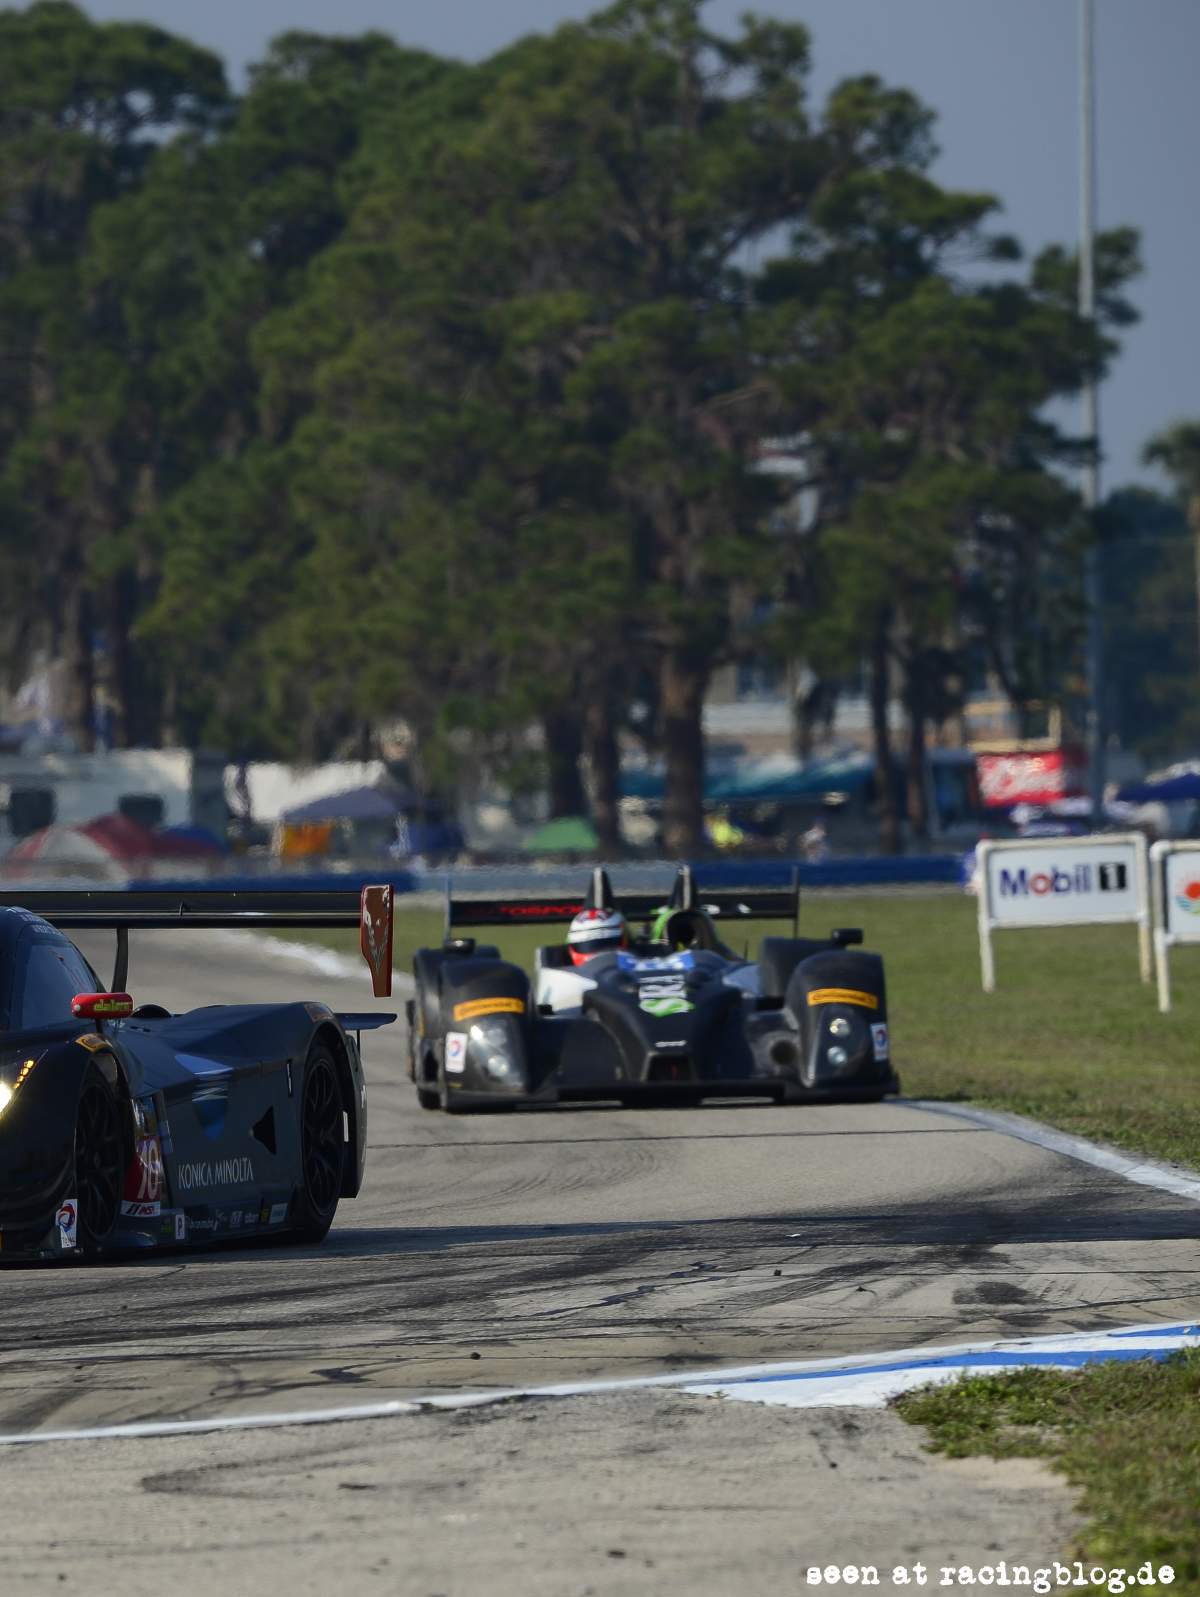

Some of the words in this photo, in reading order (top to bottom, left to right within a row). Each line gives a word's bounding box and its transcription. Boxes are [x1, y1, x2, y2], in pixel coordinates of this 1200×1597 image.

[999, 863, 1091, 897] Mobil
[178, 1160, 213, 1190] KONICA
[215, 1156, 254, 1185] MINOLTA
